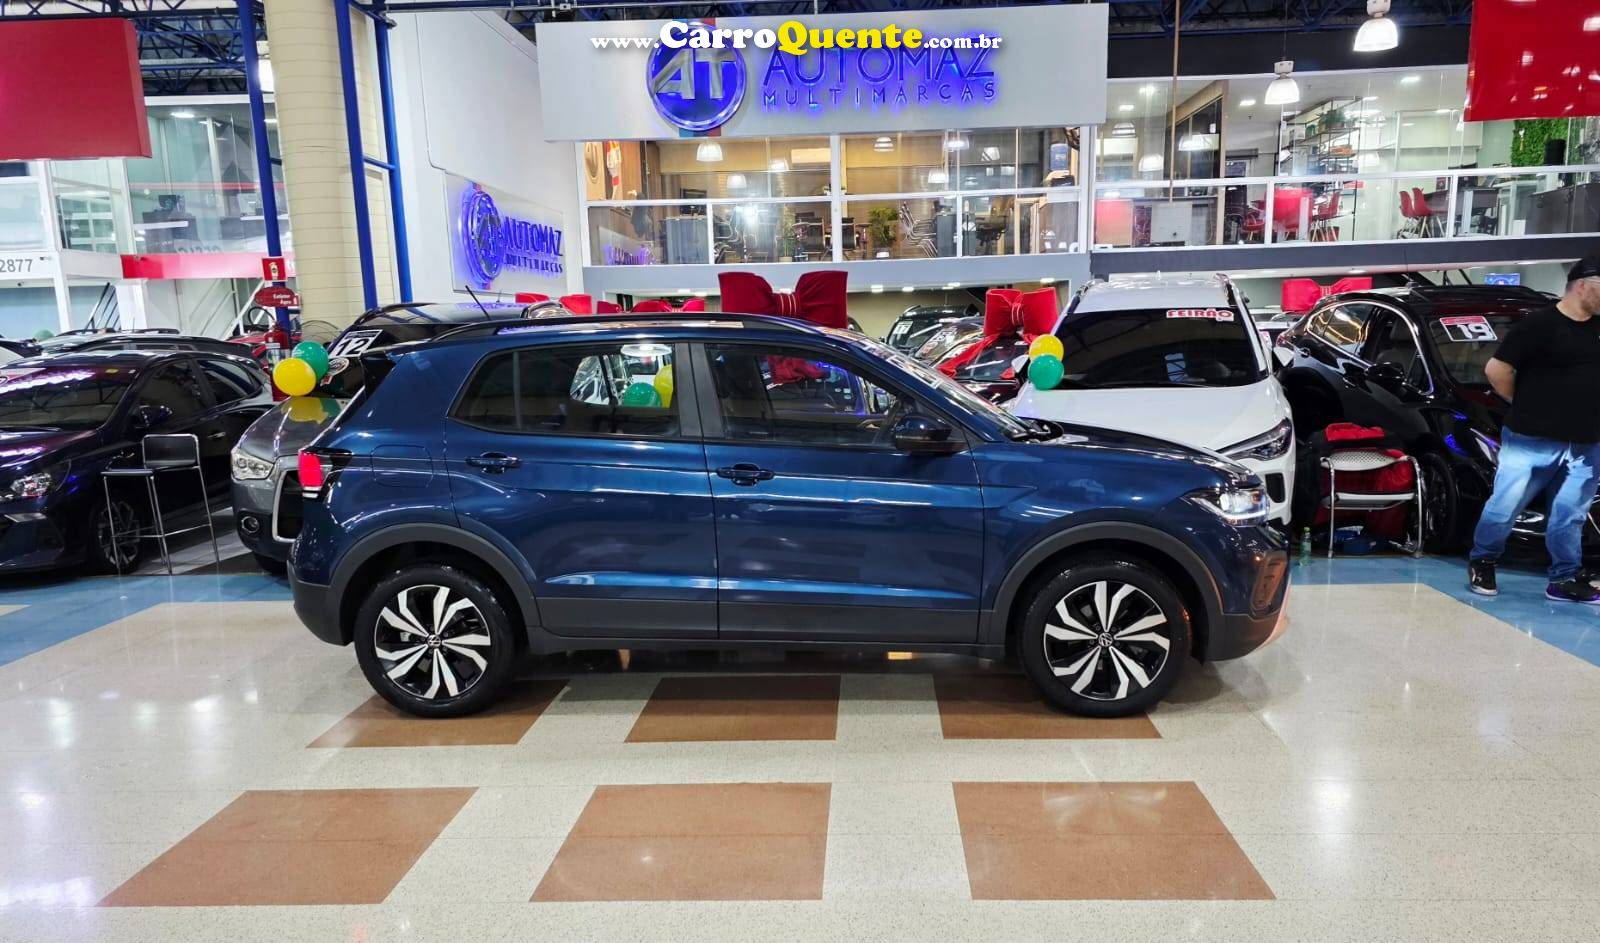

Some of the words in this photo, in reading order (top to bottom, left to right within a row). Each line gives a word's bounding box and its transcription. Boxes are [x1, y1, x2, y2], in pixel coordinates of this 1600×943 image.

[763, 37, 1001, 86] AUTOMAZ
[763, 82, 995, 106] MULTIMARCAS
[502, 216, 563, 256] AUTOMAZ
[0, 258, 33, 273] 2877
[1166, 308, 1233, 319] FEIRÃO
[1456, 323, 1494, 340] 19
[336, 338, 370, 357] 12
